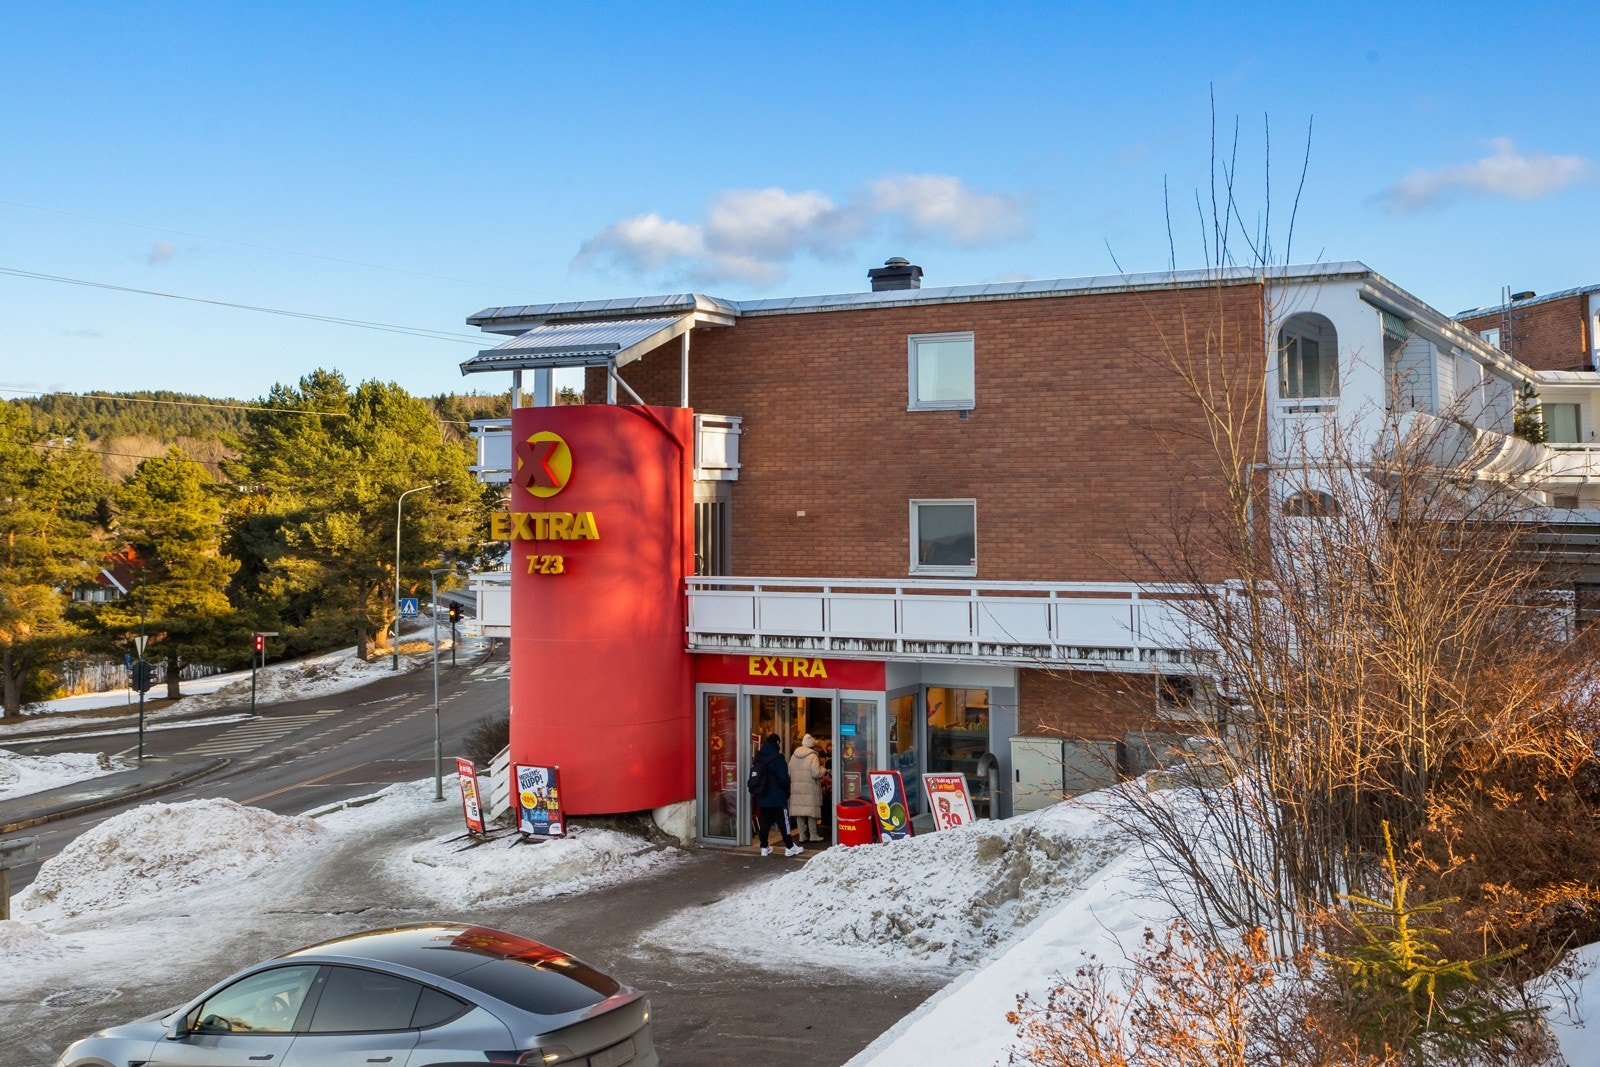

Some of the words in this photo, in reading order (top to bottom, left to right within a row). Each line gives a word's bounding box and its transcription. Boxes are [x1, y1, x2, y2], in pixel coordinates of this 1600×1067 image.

[514, 440, 561, 488] X
[490, 511, 600, 541] EXTRA
[526, 555, 564, 574] 7-23
[749, 656, 828, 678] EXTRA
[520, 774, 544, 790] KUPP!
[875, 781, 893, 800] KUPP!
